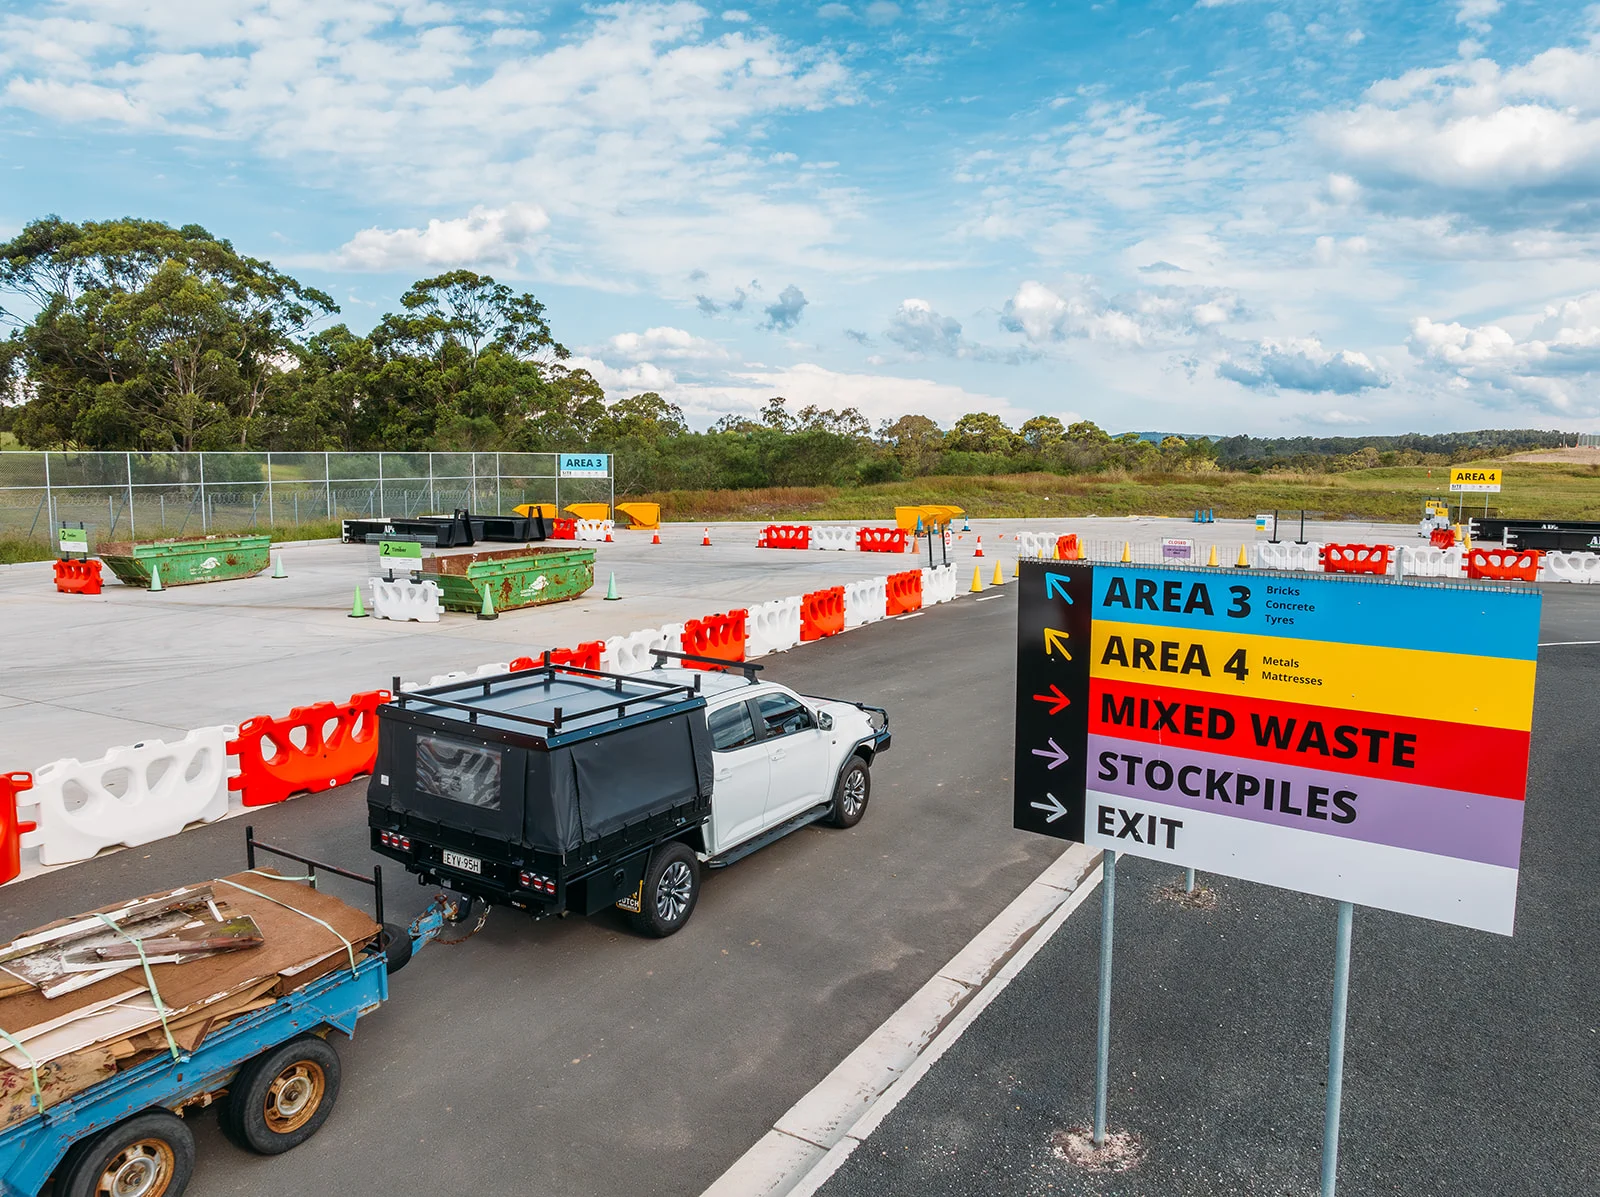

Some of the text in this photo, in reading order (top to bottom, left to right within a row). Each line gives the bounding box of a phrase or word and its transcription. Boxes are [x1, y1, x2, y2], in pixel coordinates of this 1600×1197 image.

[566, 459, 602, 467] AREA 3
[1456, 472, 1496, 481] AREA 4
[61, 530, 66, 540] 2
[383, 543, 390, 555] 2
[1266, 585, 1300, 596] Bricks
[1102, 576, 1251, 618] AREA 3
[1265, 600, 1316, 612] Concrete
[1265, 614, 1295, 625] Tyres
[1100, 635, 1249, 682] AREA 4
[1262, 656, 1300, 668] Metals
[1261, 671, 1323, 686] Mattresses
[1101, 692, 1418, 769] MIXED WASTE
[1097, 751, 1359, 825] STOCKPILES
[1097, 804, 1184, 850] EXIT
